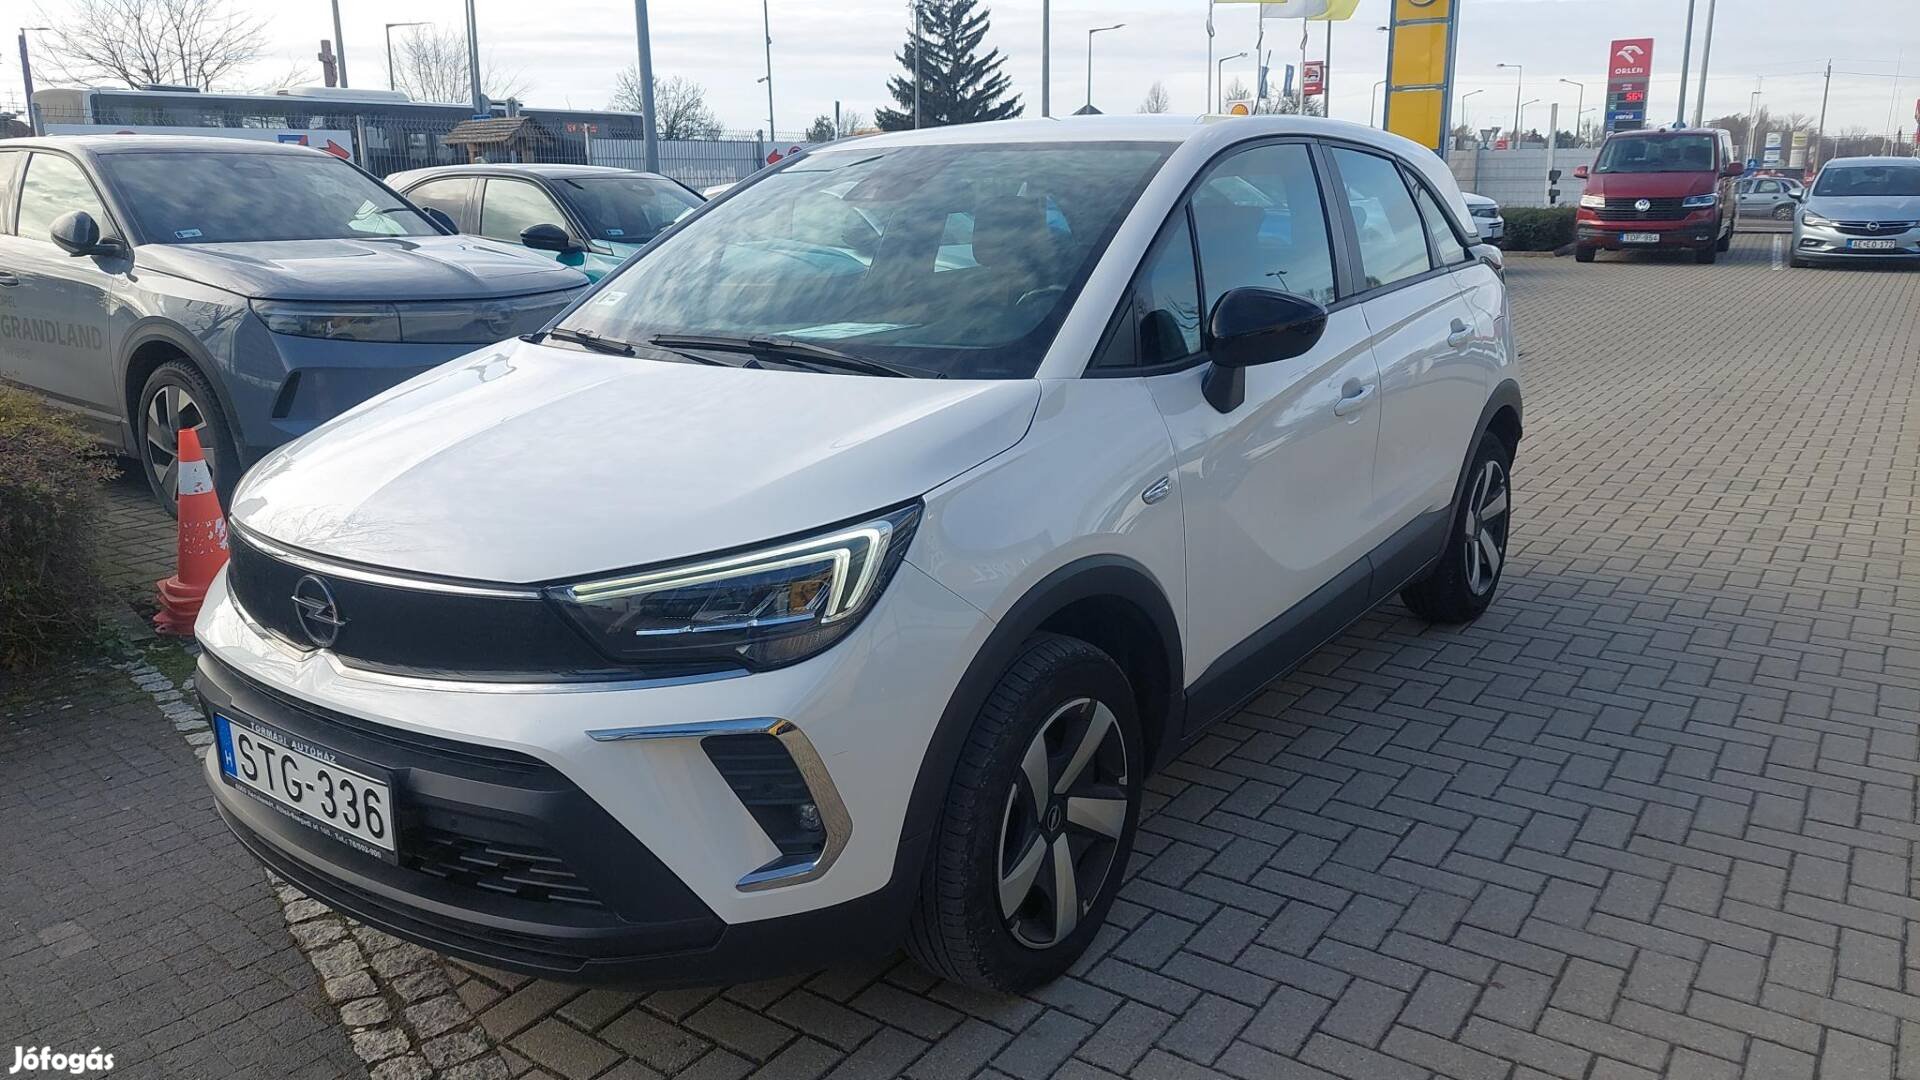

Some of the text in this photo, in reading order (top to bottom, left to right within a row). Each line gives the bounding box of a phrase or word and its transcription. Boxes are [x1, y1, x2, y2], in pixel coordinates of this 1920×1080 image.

[1, 314, 102, 351] GRANDLAND
[250, 722, 287, 745] TORMASI
[225, 751, 233, 766] H
[238, 733, 384, 839] STG-336
